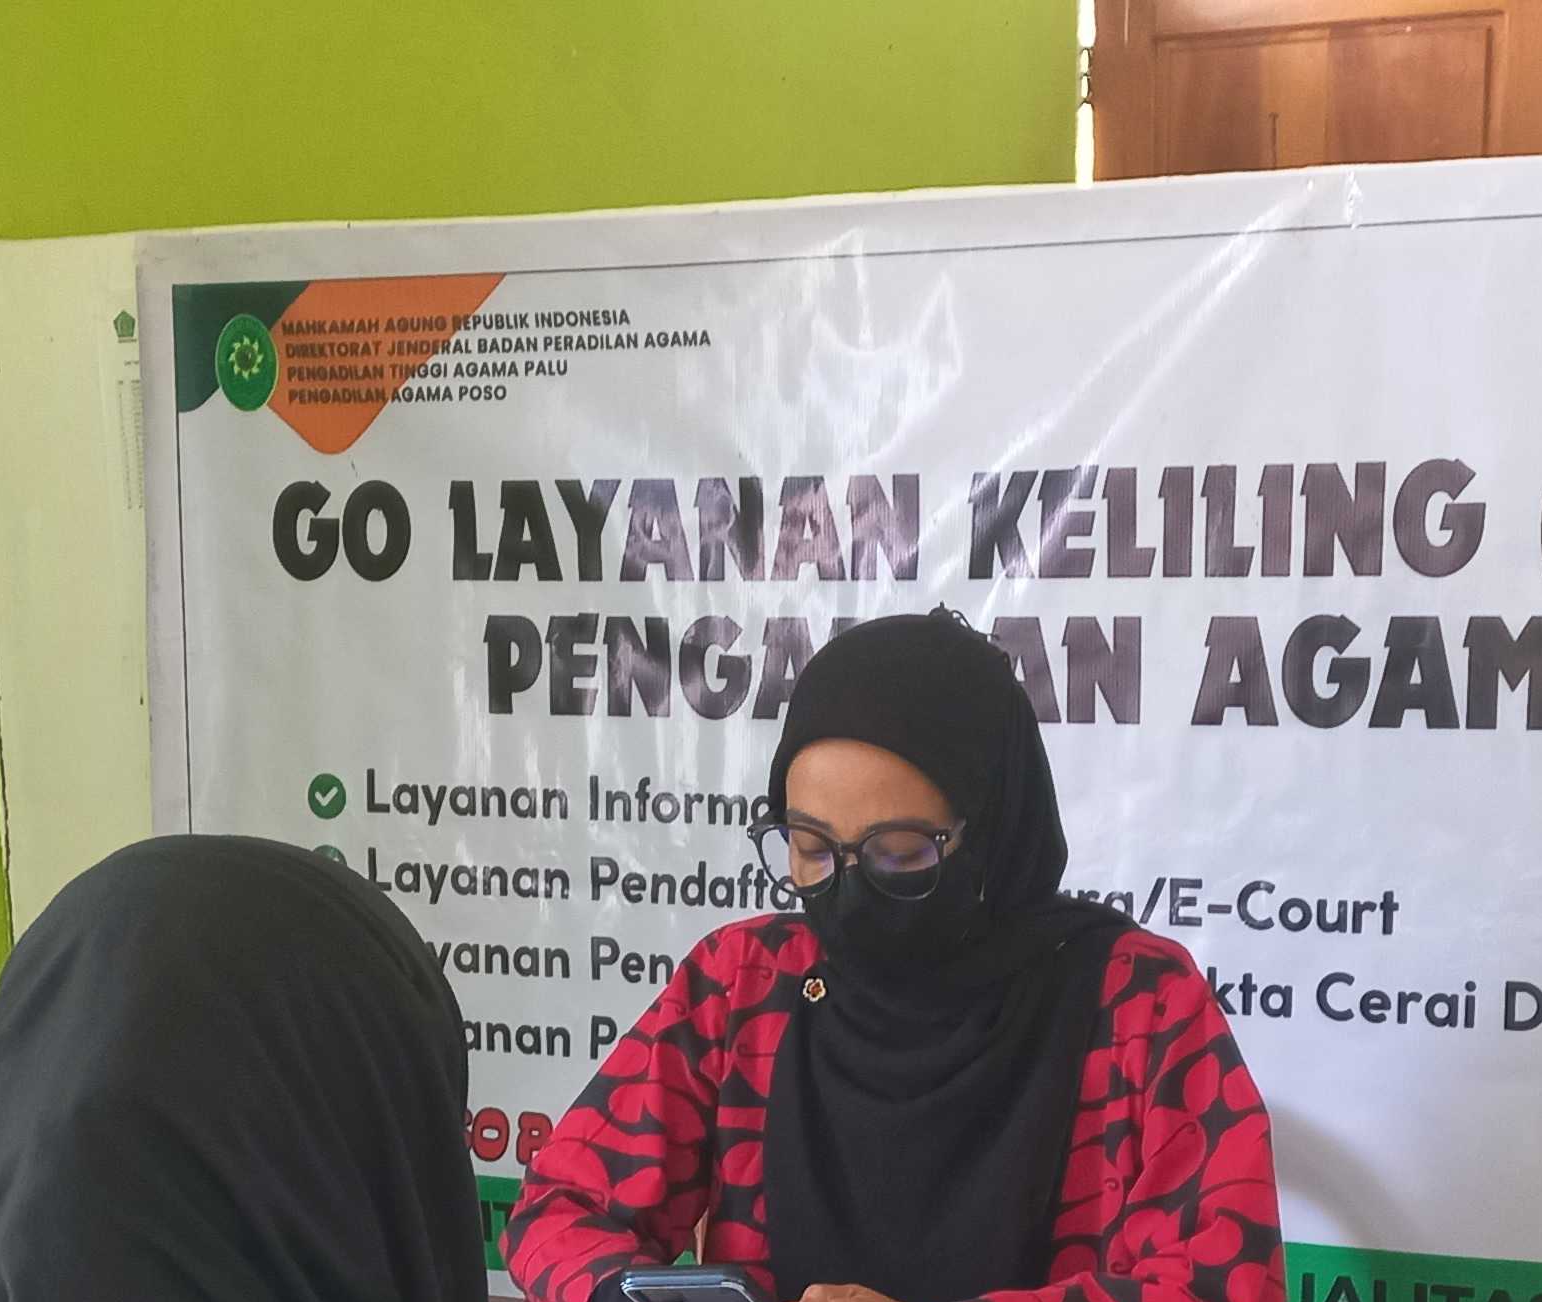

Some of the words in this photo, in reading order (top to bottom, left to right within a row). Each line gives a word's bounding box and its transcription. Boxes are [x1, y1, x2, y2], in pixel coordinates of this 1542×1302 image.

[282, 318, 380, 337] MAHKAMAH
[384, 315, 447, 333] AGUNG
[452, 312, 530, 332] REPUBLIK
[534, 309, 631, 329] INDONESIA
[285, 339, 382, 359] DIREKTORAT
[386, 337, 472, 356] JENDERAL
[477, 336, 538, 354] BADAN
[542, 332, 639, 352] PERADILAN
[643, 330, 712, 349] AGAMA
[287, 363, 385, 382] PENGADILAN
[389, 361, 448, 380] TINGGI
[453, 360, 519, 379] AGAMA
[524, 359, 569, 377] PALU
[288, 387, 387, 405] PENGADILAN
[390, 385, 454, 403] AGAMA
[458, 385, 508, 402] POSO
[272, 478, 412, 582] GO
[447, 472, 921, 583] LAYANAN
[967, 458, 1487, 581] KELILING
[365, 768, 570, 826] Layanan
[367, 847, 571, 905] Layanan
[590, 856, 798, 911] Pendafta
[590, 936, 674, 985] Pen
[1207, 966, 1293, 1019] kta
[1316, 971, 1476, 1030] Cerai
[462, 1019, 571, 1058] anan
